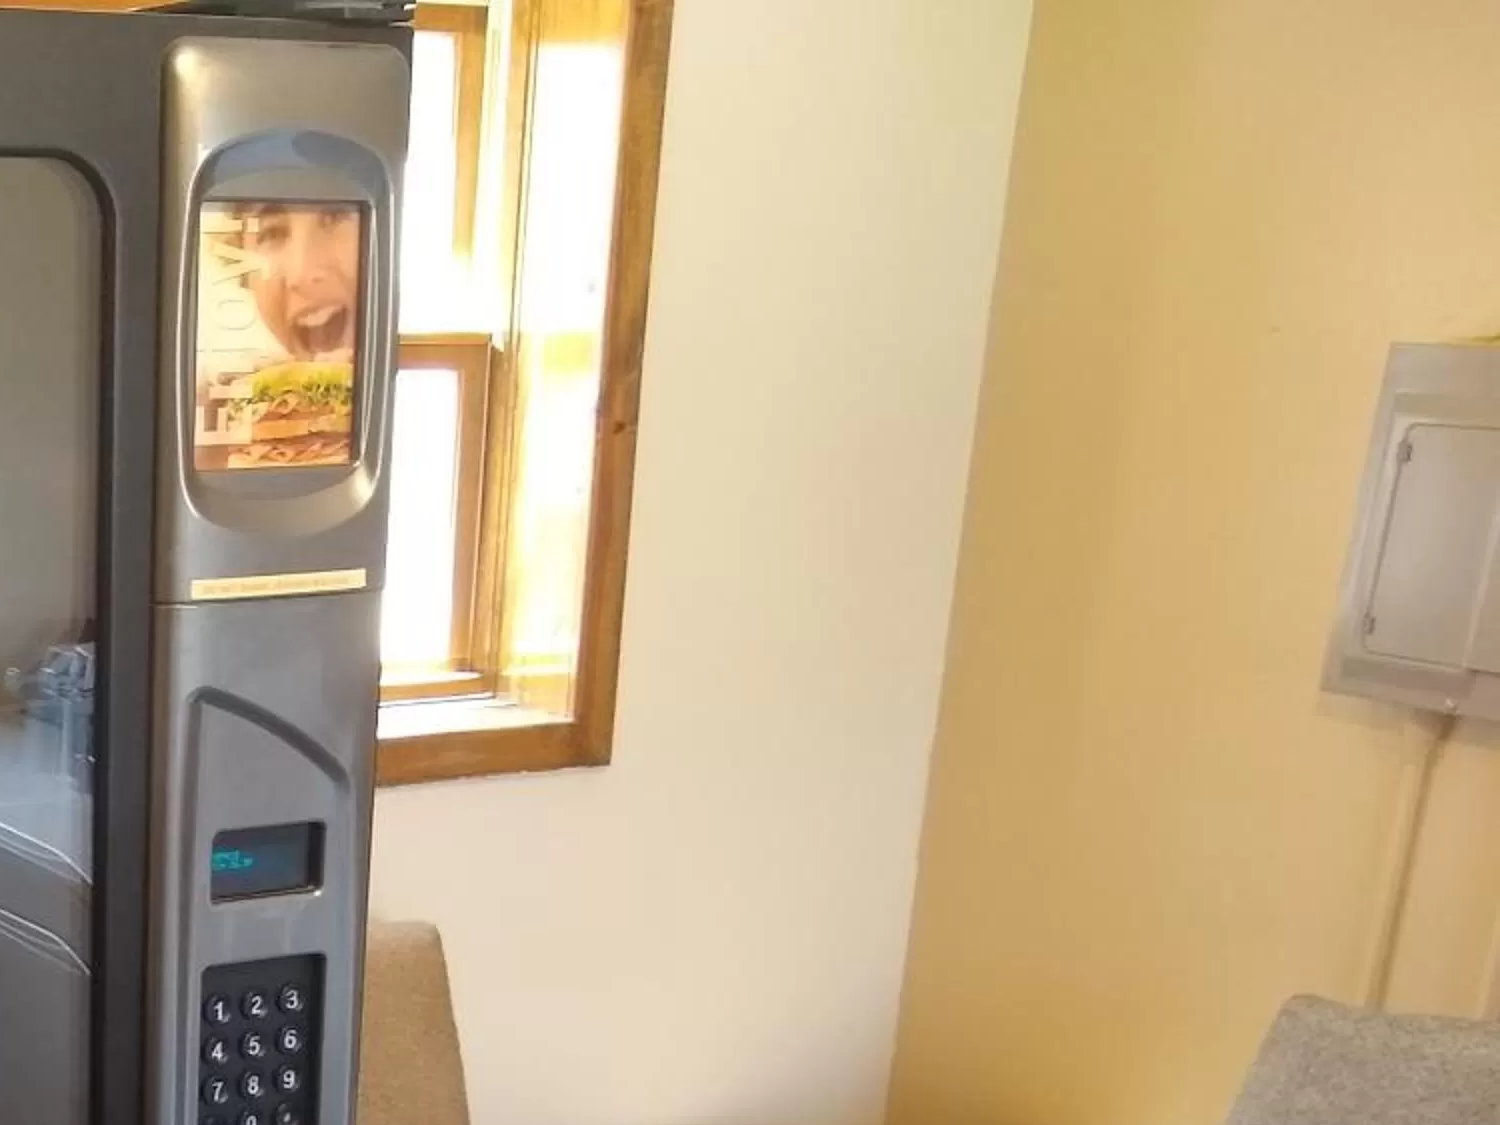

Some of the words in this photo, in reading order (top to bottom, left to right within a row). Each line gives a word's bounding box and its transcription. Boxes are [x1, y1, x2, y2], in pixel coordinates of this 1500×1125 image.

[214, 1001, 223, 1021] 1
[251, 995, 262, 1014] 2
[286, 989, 298, 1009] 3
[212, 1041, 223, 1060] 4
[249, 1035, 260, 1055] 5
[284, 1029, 297, 1049] 6
[212, 1082, 224, 1101] 7
[248, 1075, 259, 1094] 8
[283, 1069, 295, 1089] 9
